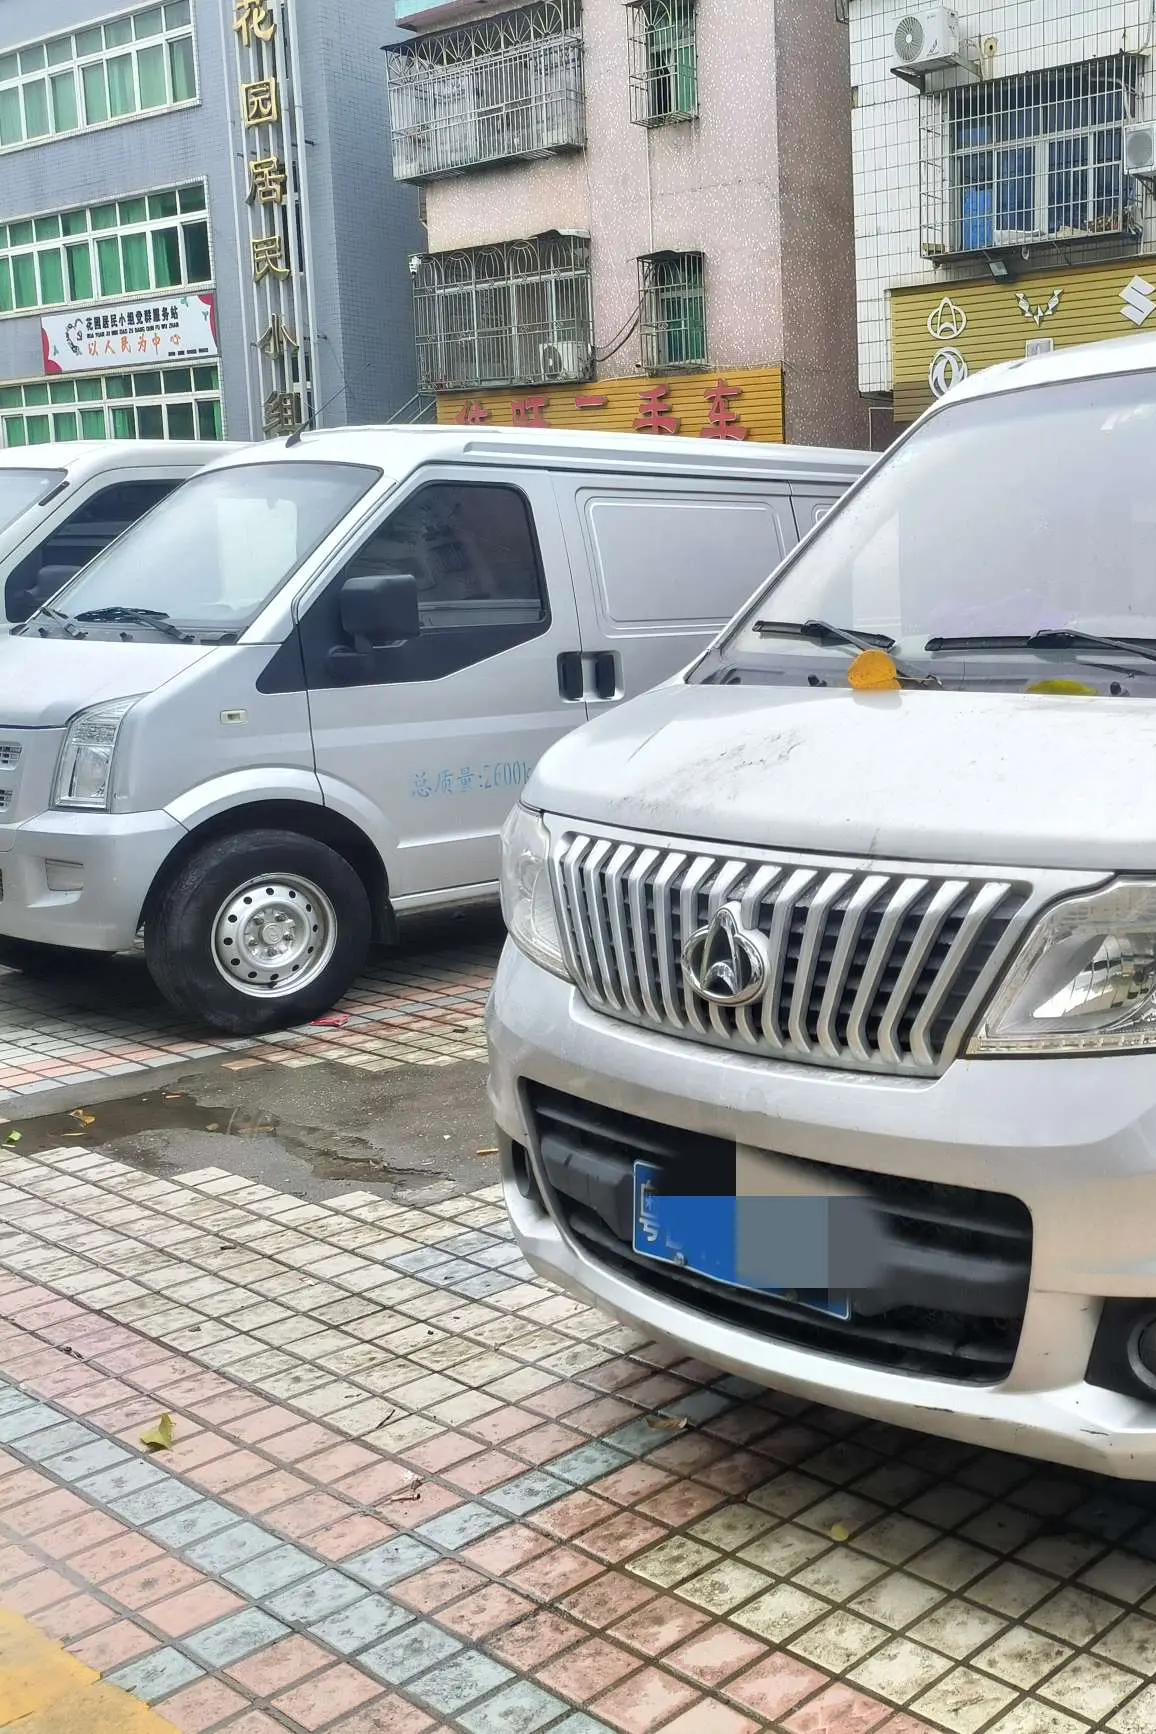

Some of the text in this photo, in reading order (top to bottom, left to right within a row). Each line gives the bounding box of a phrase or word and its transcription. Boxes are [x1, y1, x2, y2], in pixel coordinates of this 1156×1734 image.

[234, 0, 302, 437] 花园居民小组
[85, 305, 179, 331] 花园居民小组党群服务站
[88, 333, 181, 357] 以人民为中心
